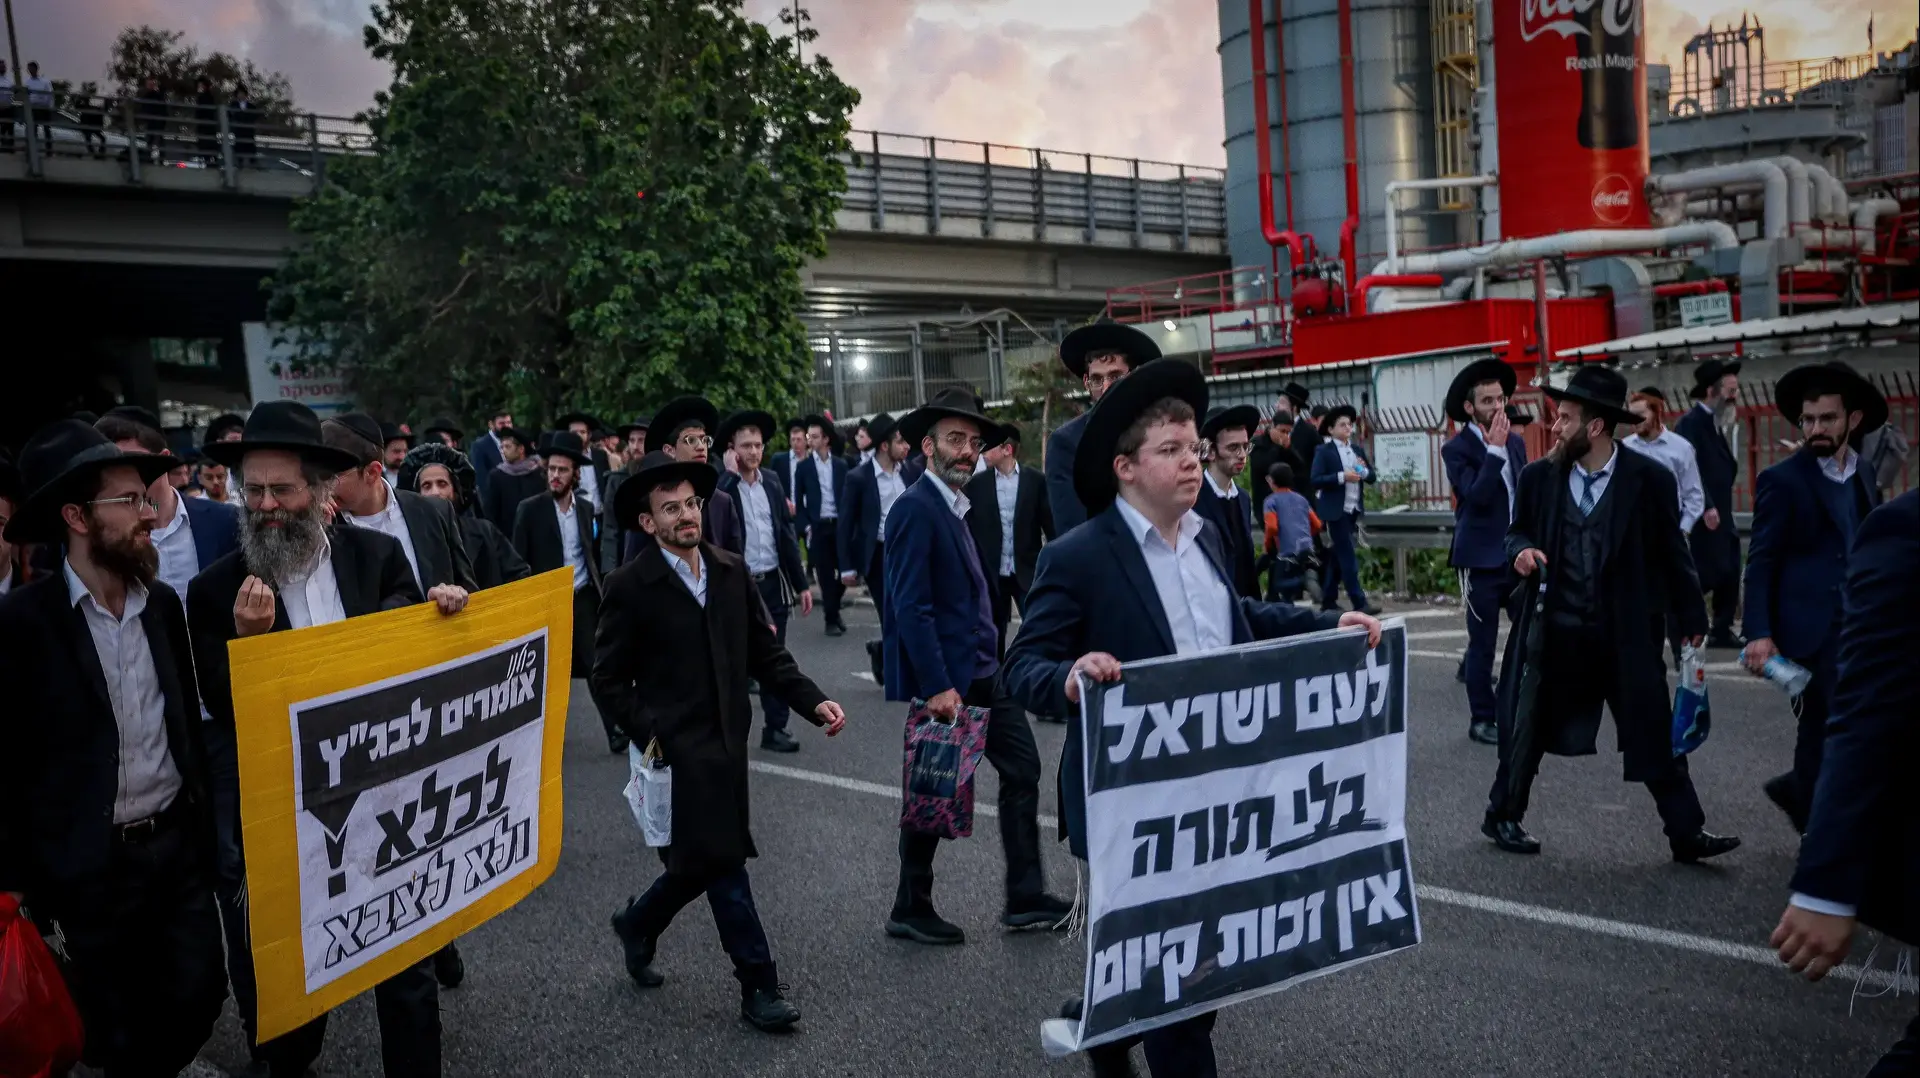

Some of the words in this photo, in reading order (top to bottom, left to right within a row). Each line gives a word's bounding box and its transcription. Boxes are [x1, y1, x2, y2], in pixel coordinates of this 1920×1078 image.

[1565, 54, 1602, 71] Real
[441, 667, 538, 738] אומרים
[506, 642, 537, 681] כולנו
[1295, 648, 1391, 733] לעם
[1103, 682, 1281, 764] ישראל
[374, 742, 513, 870] לכלא
[1131, 793, 1276, 880] תורה
[1293, 761, 1367, 835] בלי
[464, 814, 531, 894] ולא
[324, 847, 456, 969] לצבא
[1217, 890, 1326, 968] זכות
[1338, 869, 1409, 953] אין
[1092, 922, 1203, 1006] קיום
